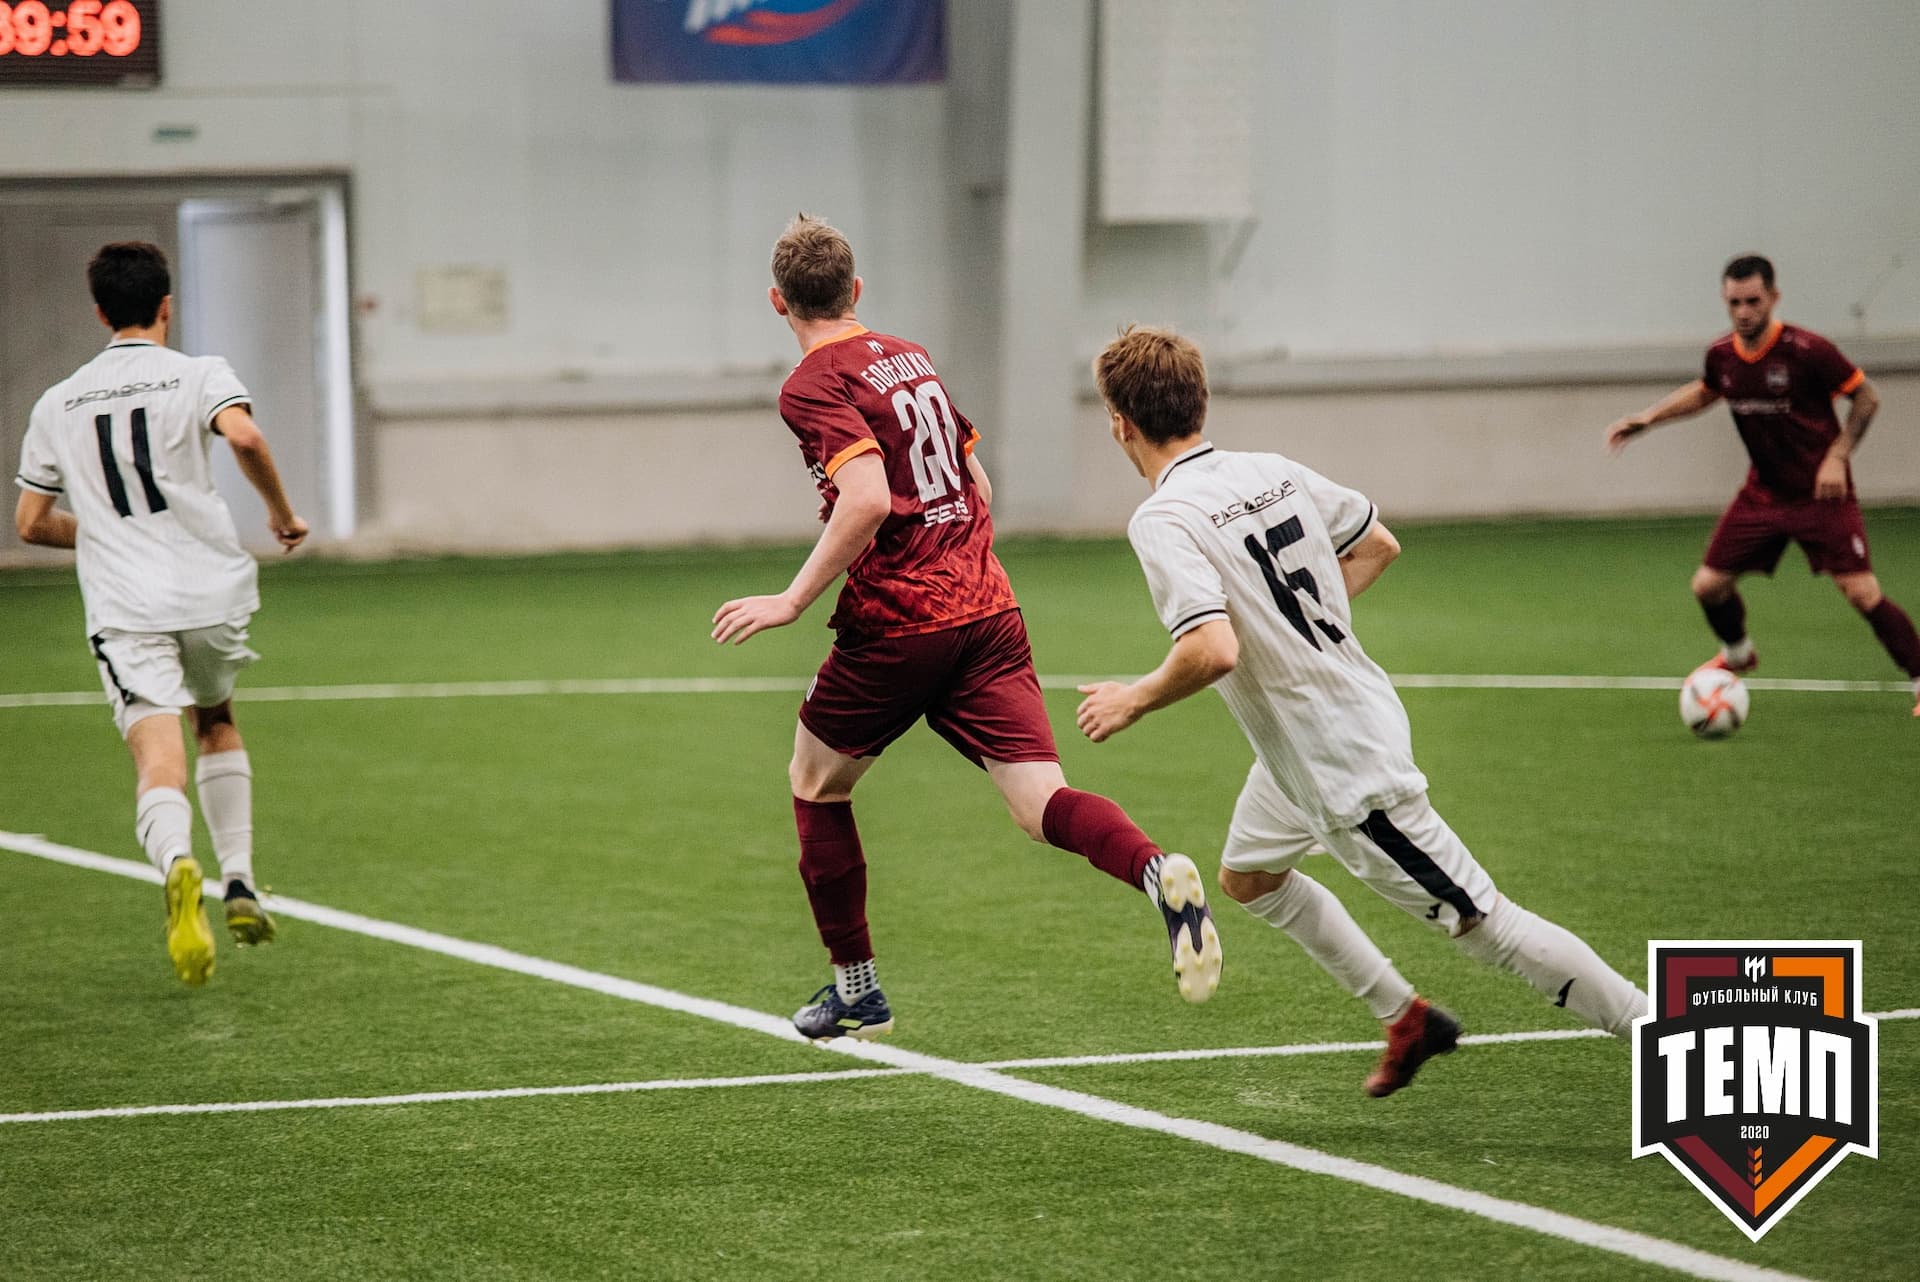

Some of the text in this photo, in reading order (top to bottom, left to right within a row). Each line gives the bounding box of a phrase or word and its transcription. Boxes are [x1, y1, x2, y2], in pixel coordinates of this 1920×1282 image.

[95, 407, 169, 518] 11
[891, 380, 961, 504] 20
[1244, 515, 1346, 652] 15
